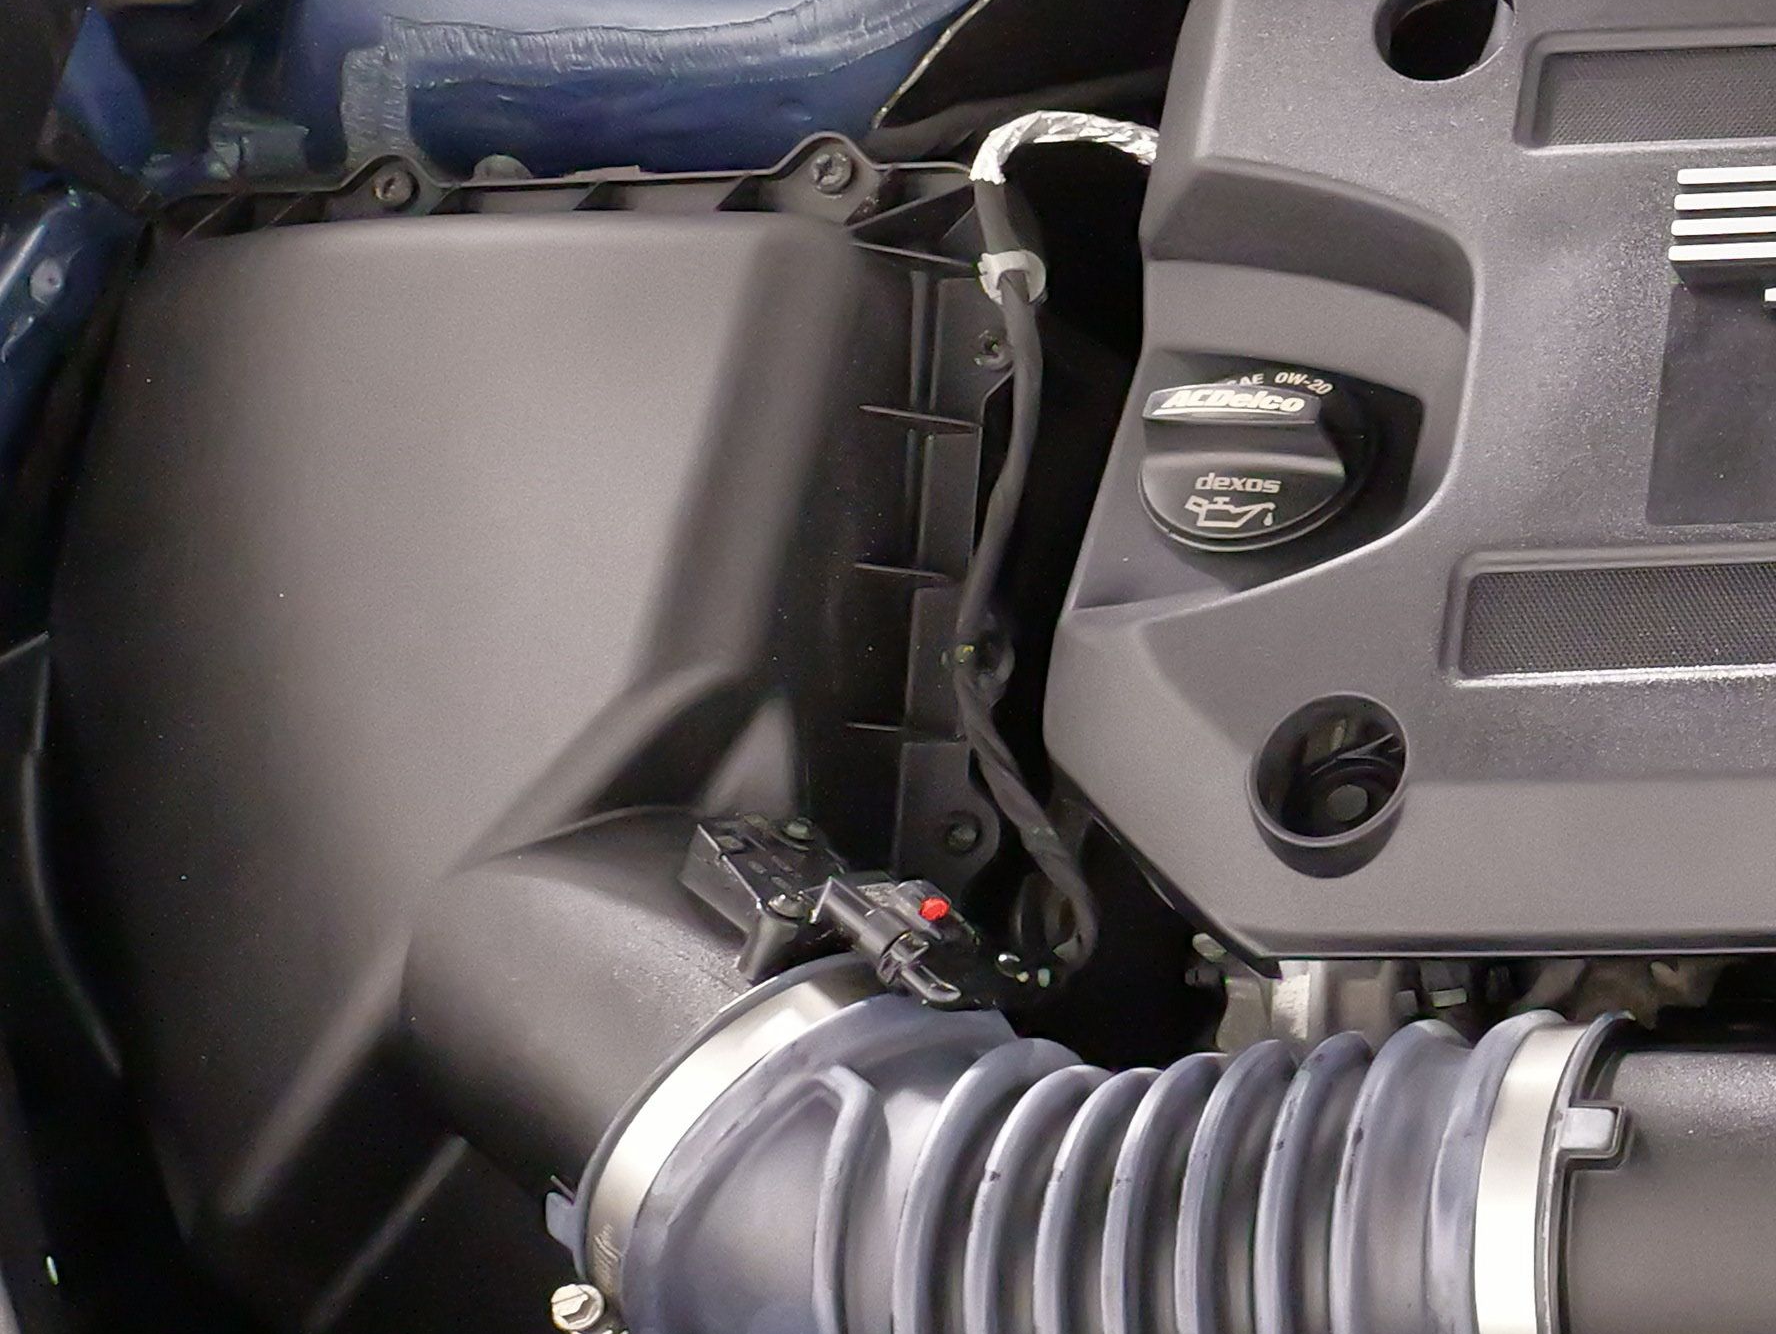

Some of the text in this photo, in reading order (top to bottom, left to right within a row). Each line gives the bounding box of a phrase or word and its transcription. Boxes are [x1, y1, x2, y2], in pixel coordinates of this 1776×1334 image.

[1274, 371, 1334, 395] 0W-20
[1160, 388, 1306, 412] ACDelco
[1194, 472, 1282, 493] dexos
